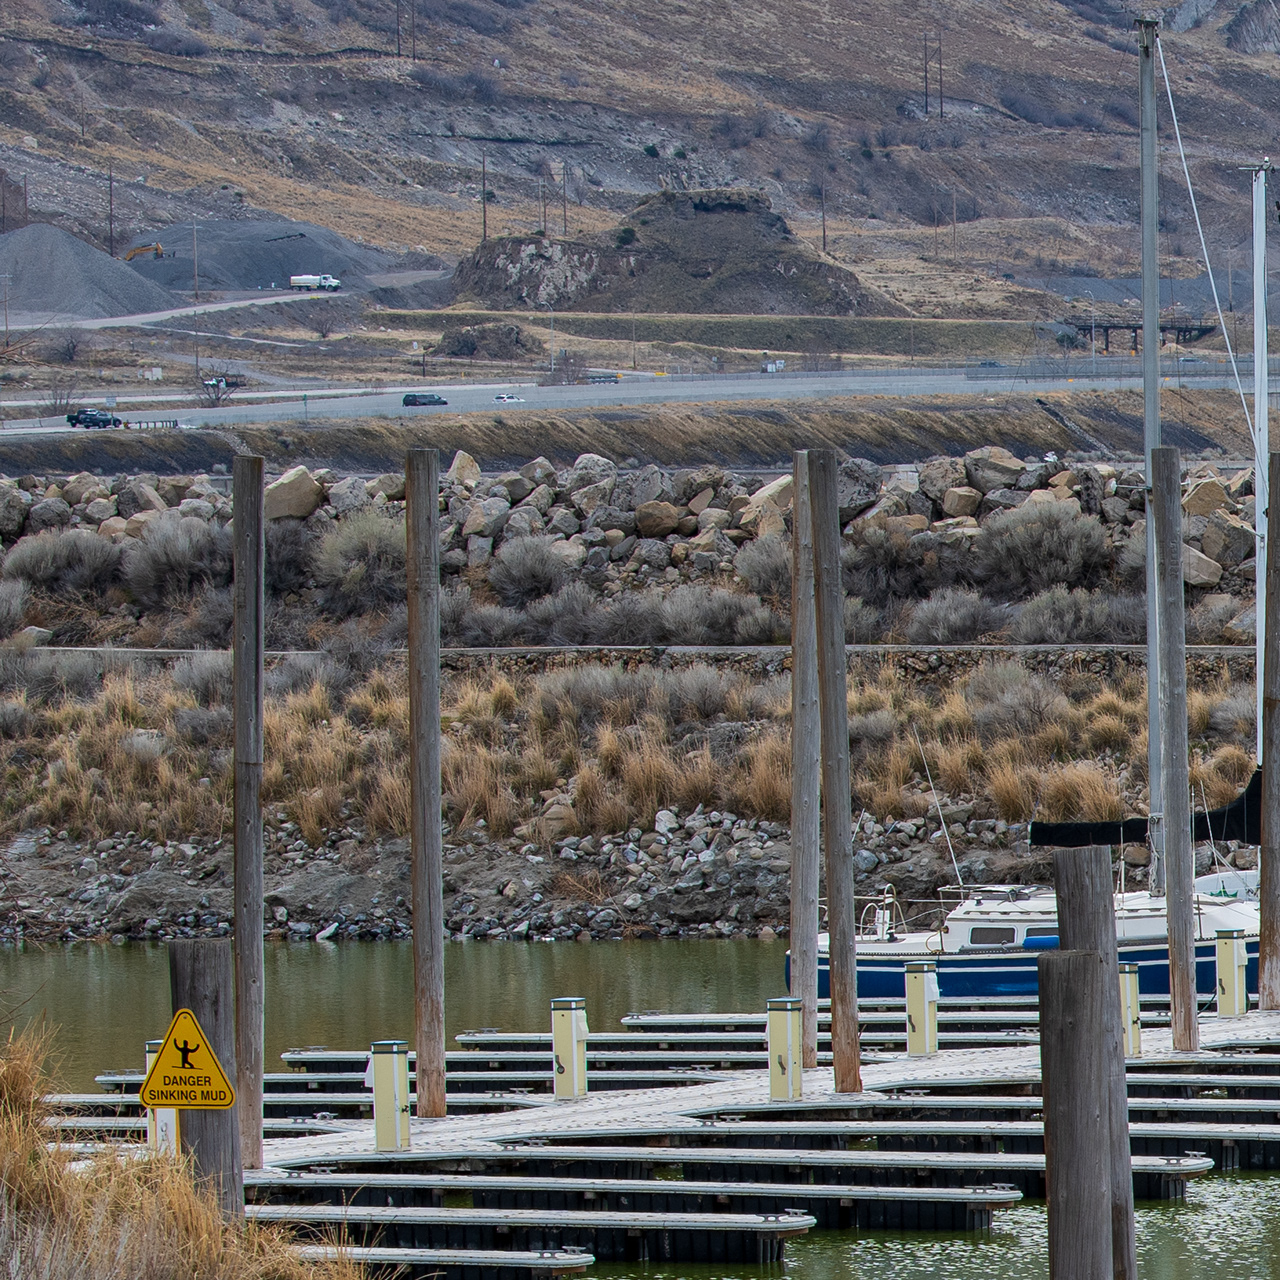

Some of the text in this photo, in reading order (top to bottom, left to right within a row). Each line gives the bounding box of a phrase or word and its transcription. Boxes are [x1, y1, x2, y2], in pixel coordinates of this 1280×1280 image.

[163, 1075, 212, 1087] DANGER
[149, 1089, 228, 1101] SINKING MUD
